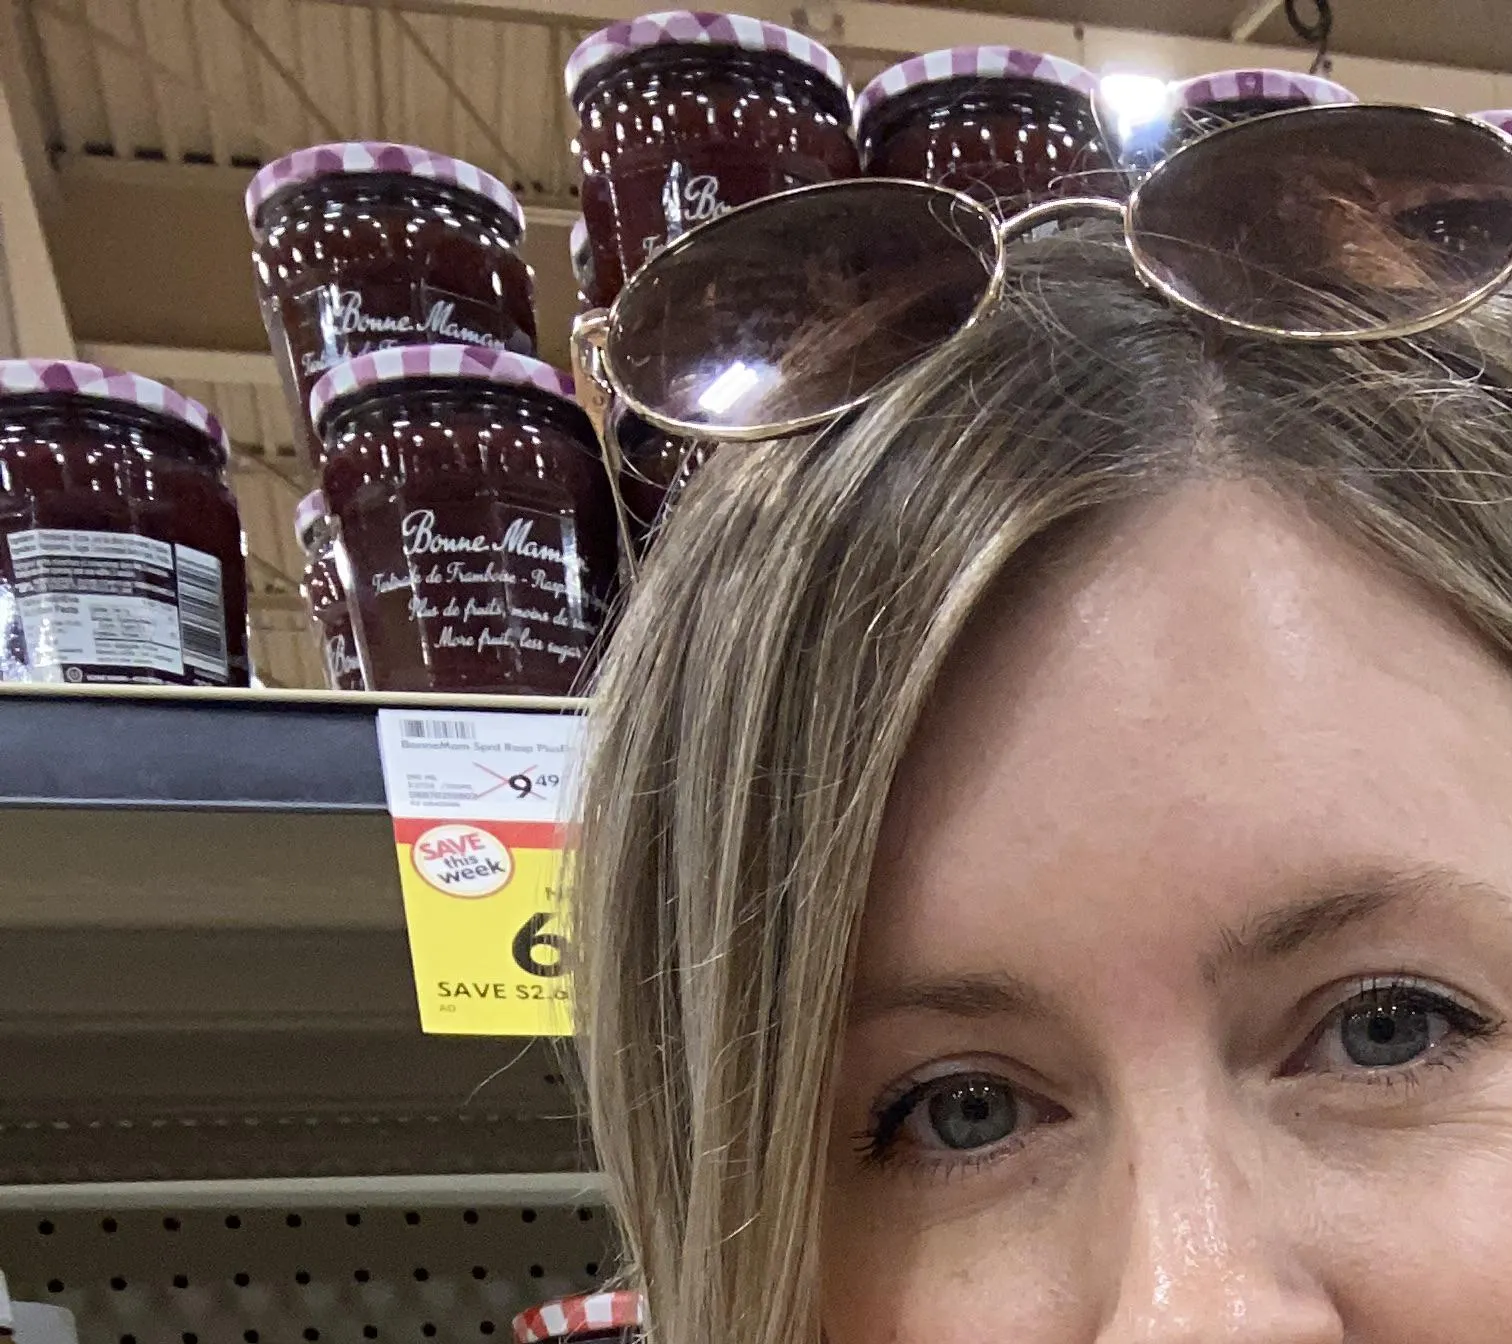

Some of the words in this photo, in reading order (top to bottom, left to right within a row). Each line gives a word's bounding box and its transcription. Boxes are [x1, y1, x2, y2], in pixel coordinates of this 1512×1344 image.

[402, 509, 489, 554] Bonne
[420, 832, 485, 861] SAVE
[437, 857, 506, 884] week
[444, 854, 478, 869] this
[437, 981, 507, 1000] SAVE
